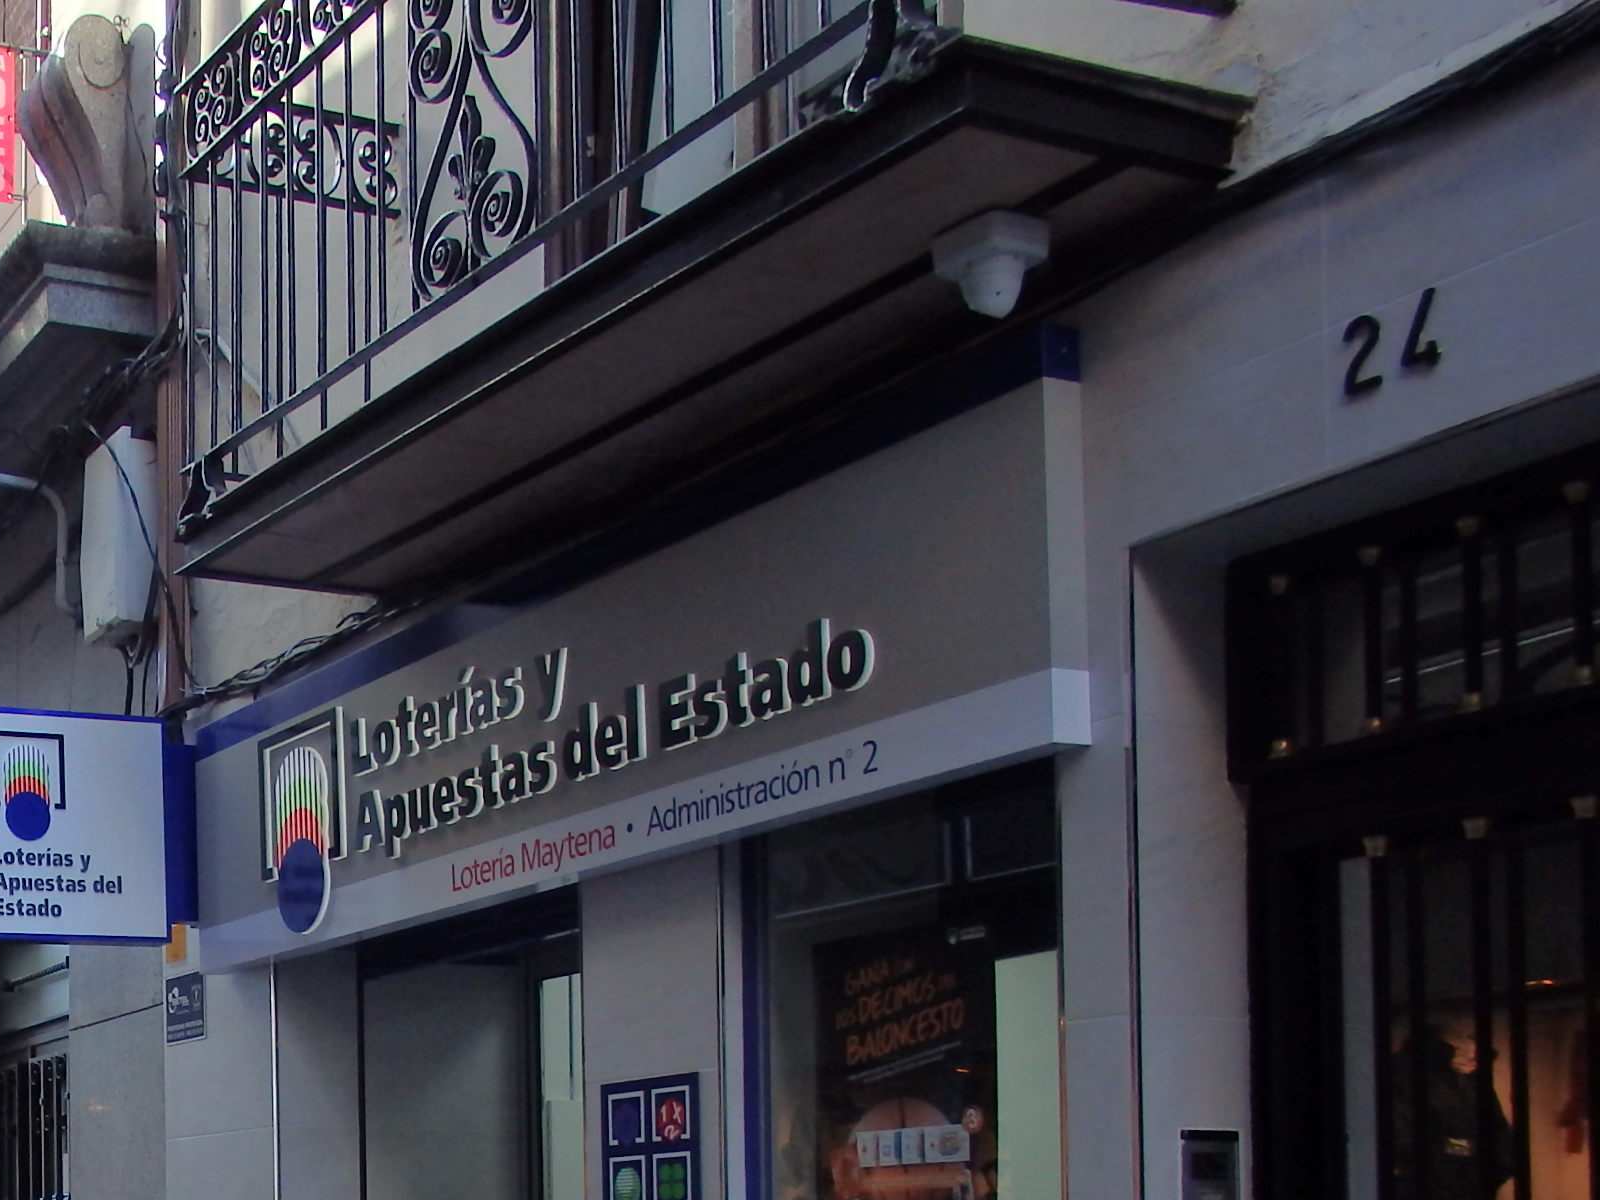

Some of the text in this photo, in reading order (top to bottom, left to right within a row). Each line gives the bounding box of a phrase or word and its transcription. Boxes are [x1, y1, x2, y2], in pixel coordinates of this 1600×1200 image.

[1342, 287, 1442, 396] 24
[350, 646, 569, 775] Loterías y
[355, 619, 875, 858] Apuestas del Estado
[80, 852, 91, 872] y
[450, 846, 516, 893] Lotería
[520, 822, 617, 879] Maytena
[647, 760, 822, 838] Administración
[861, 740, 879, 774] 2
[93, 874, 123, 895] del
